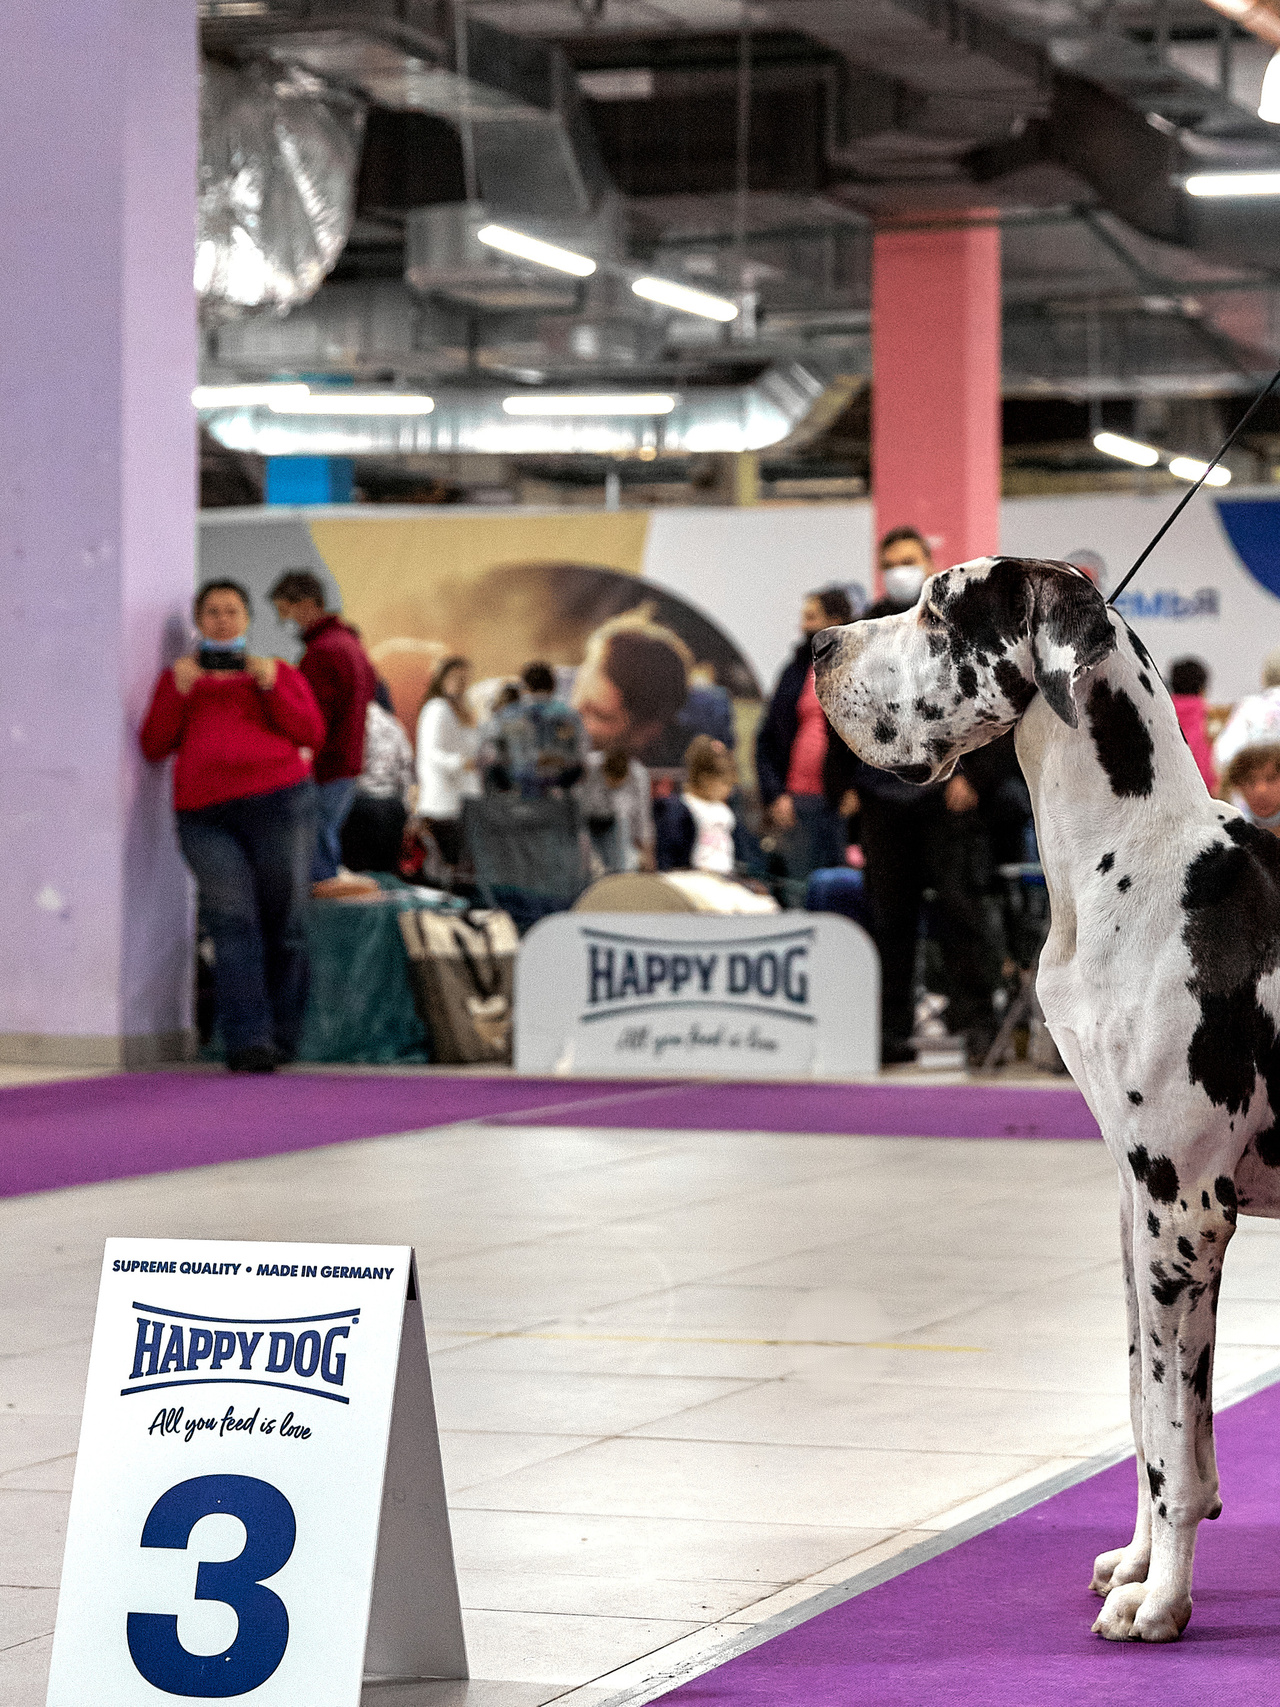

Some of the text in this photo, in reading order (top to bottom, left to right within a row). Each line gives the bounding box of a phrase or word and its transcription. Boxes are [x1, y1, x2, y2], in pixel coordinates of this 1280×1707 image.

[589, 945, 808, 1005] HAPPY DOG
[112, 1259, 395, 1280] SUPREME QUALITY MADE IN GERMANY
[128, 1317, 351, 1387] HAPPY DOG
[148, 1405, 313, 1443] All you feed is love
[126, 1473, 297, 1699] 3
